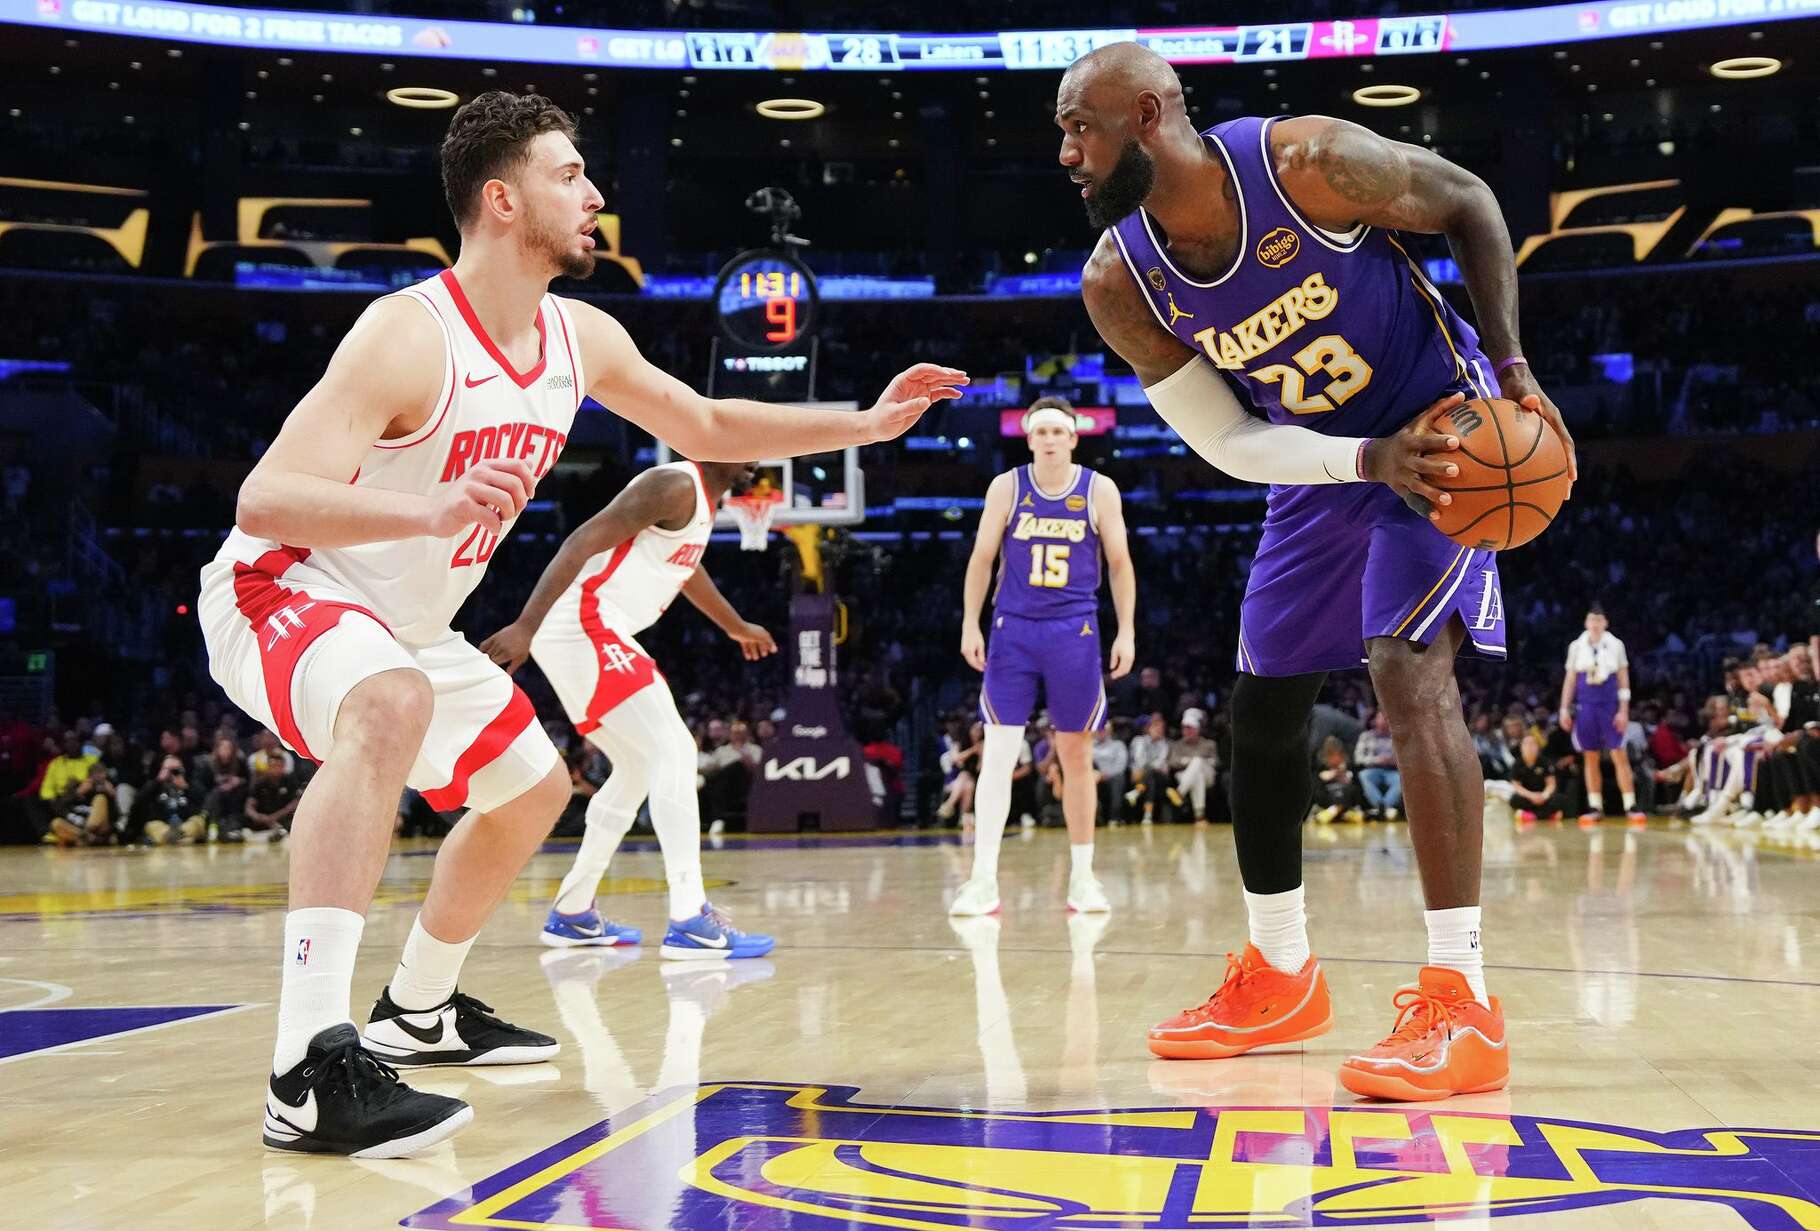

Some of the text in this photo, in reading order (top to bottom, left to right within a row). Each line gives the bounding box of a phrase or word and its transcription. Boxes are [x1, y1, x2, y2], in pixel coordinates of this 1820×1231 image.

[72, 0, 403, 47] GET LOUD FOR 2 FREE TACOS
[1609, 3, 1651, 28] GET
[1654, 0, 1717, 23] LOUD
[608, 37, 654, 60] GET
[842, 38, 882, 64] 28
[920, 41, 985, 60] Lakers
[1148, 37, 1224, 54] Rockets
[1256, 28, 1292, 56] 21
[1260, 233, 1296, 261] bibigo
[766, 297, 796, 342] 9
[1193, 271, 1339, 370] LAKERS
[745, 356, 808, 371] TISSOT
[1247, 334, 1374, 415] 23
[1012, 521, 1087, 544] LAKERS
[1028, 543, 1071, 589] 15
[764, 756, 850, 781] KIA
